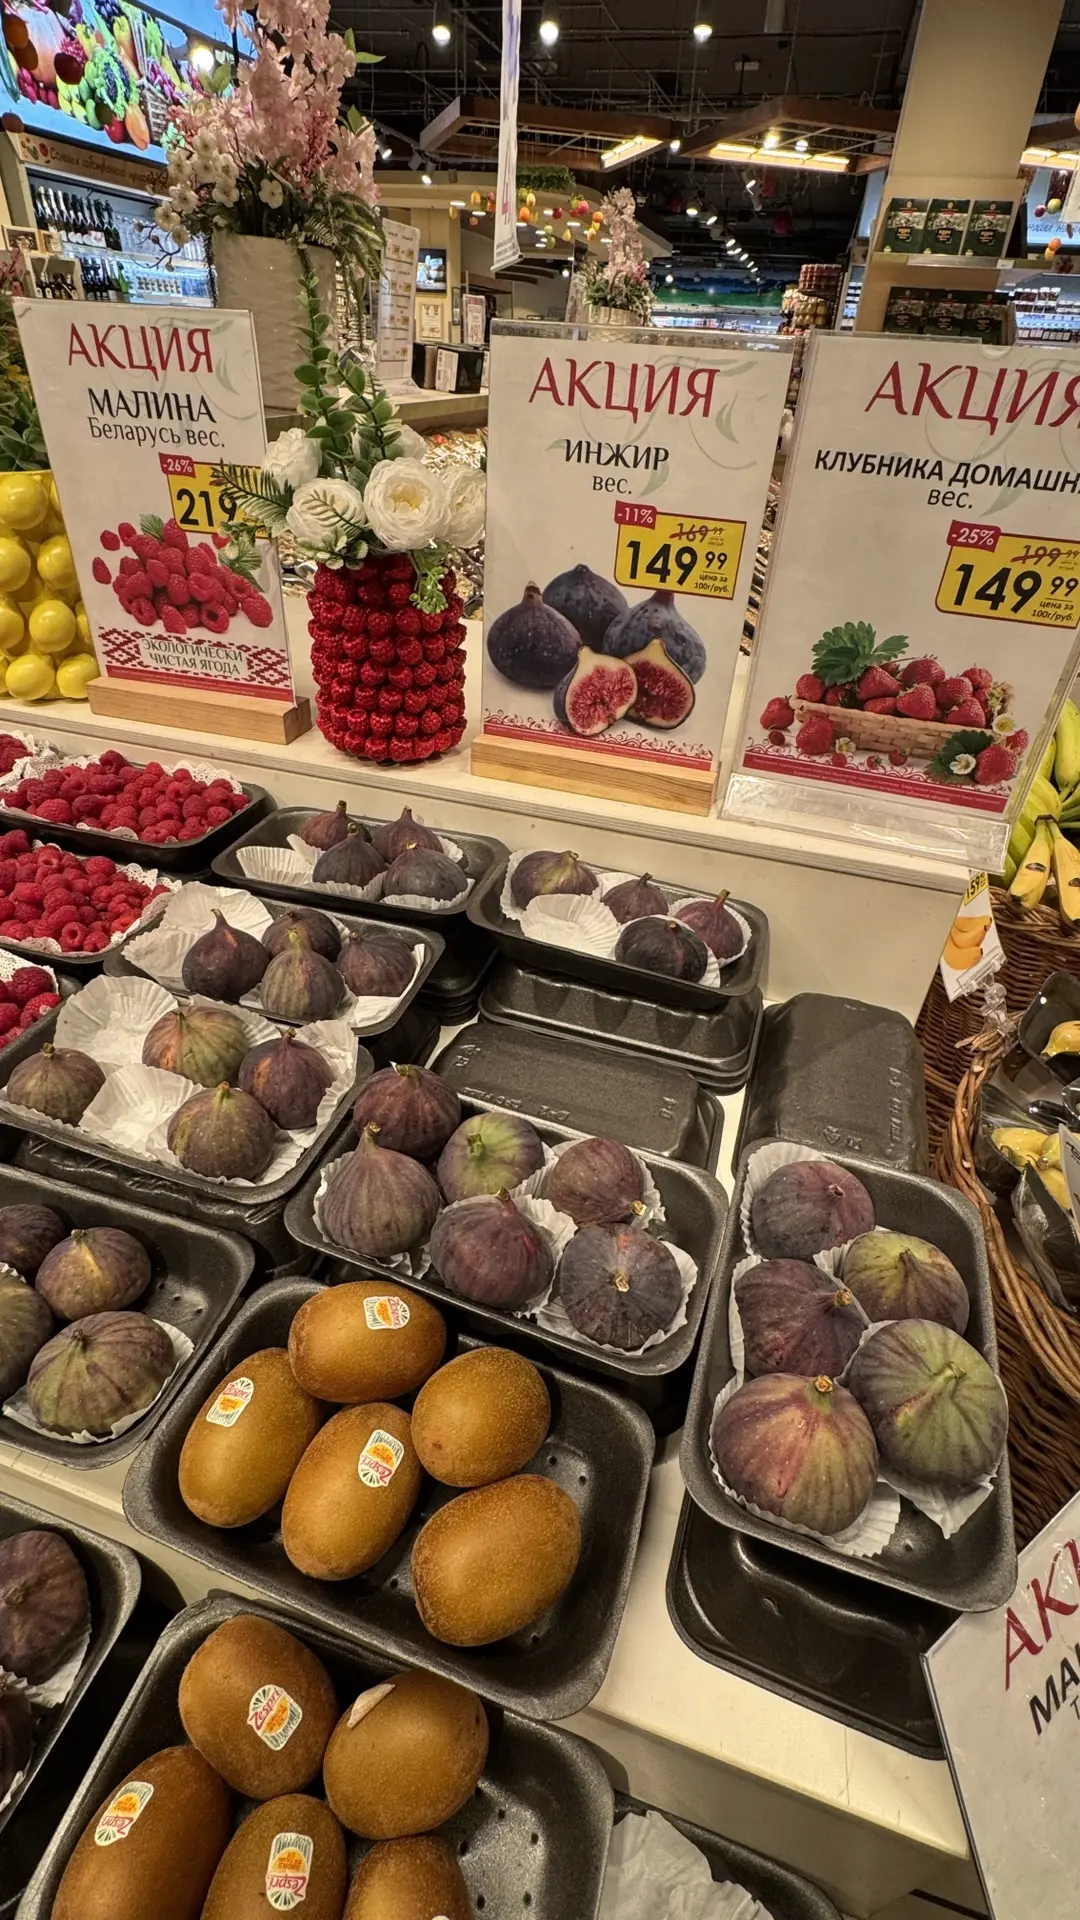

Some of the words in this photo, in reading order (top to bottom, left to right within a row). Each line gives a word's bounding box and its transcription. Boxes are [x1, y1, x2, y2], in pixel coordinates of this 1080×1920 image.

[68, 322, 214, 382] АКЦИЯ
[87, 387, 217, 424] МАЛИНА
[528, 356, 721, 424] АКЦИЯ
[864, 360, 1080, 436] АКЦИЯ
[87, 416, 181, 448] Беларусь
[186, 427, 226, 448] вес.
[163, 458, 193, 474] -26%
[564, 438, 670, 471] ИНЖИР
[592, 475, 633, 495] вес.
[814, 449, 944, 482] КЛУБНИКА
[948, 462, 1080, 494] ДОМАШН
[176, 487, 238, 528] 219
[927, 488, 974, 510] вес.
[617, 507, 653, 524] -11%
[951, 527, 995, 546] -25%
[626, 539, 698, 587] 149
[705, 550, 728, 571] 99
[699, 573, 718, 582] цена
[953, 563, 1043, 614] 149
[1050, 576, 1079, 598] 99
[1039, 600, 1062, 609] цена
[142, 638, 243, 662] ЭКОЛОГИЧЕСКИ
[149, 651, 197, 669] ЧИСТАЯ
[199, 658, 241, 676] ЯГОДА
[360, 1456, 394, 1485] Zespri
[1029, 1641, 1080, 1736] МА
[249, 1687, 282, 1731] Zespri
[267, 1873, 307, 1898] Zespri
